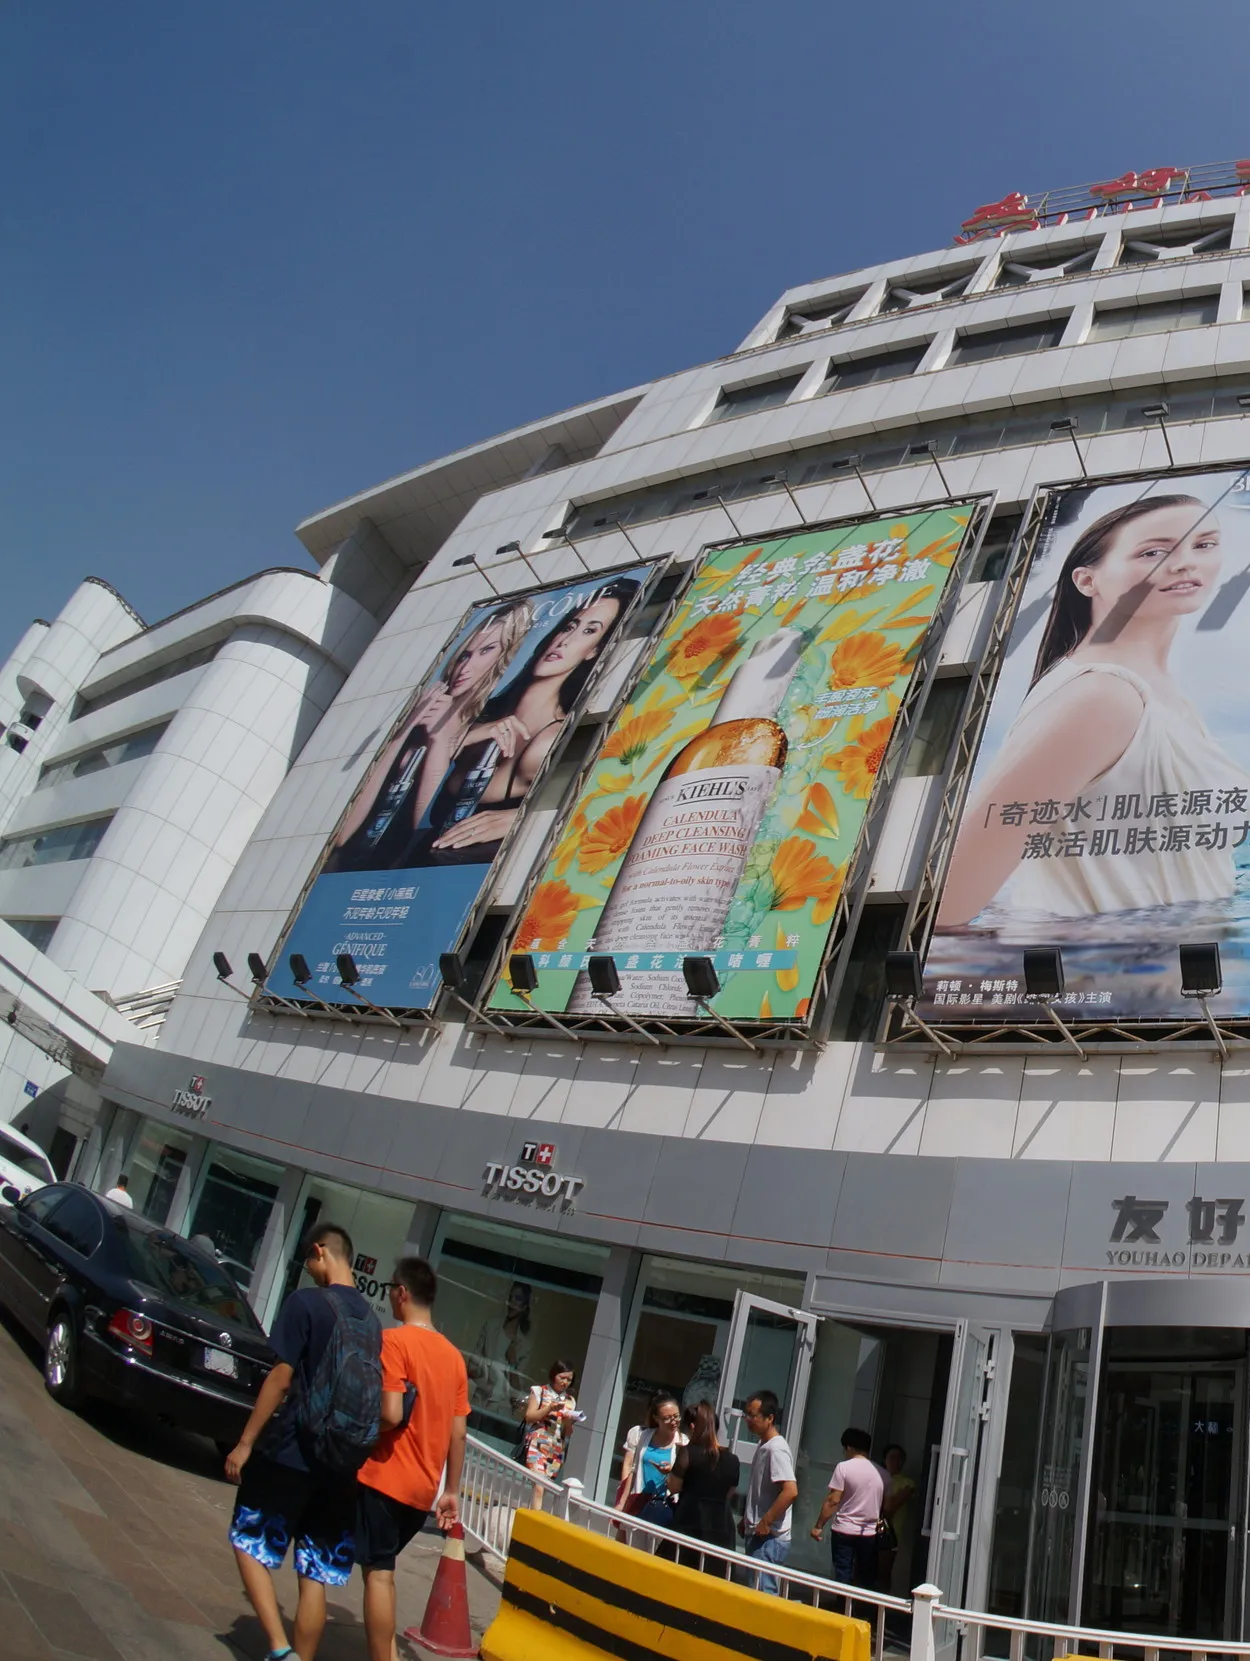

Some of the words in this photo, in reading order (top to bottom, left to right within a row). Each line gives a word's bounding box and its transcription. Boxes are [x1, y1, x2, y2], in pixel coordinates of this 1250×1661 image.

[734, 538, 906, 587] 经典金盏花
[677, 781, 748, 802] KIEHL'S
[663, 809, 738, 827] CALENDULA
[643, 830, 675, 847] DEEP
[676, 826, 748, 840] CLEANSING
[681, 842, 717, 854] FACE
[719, 842, 748, 857] WASH
[697, 877, 714, 885] skin
[933, 993, 984, 1006] 国际影星
[172, 1089, 212, 1112] TISSOT
[485, 1162, 583, 1201] TISSOT
[1106, 1250, 1186, 1267] YOUHAO
[352, 1272, 394, 1301] SOT
